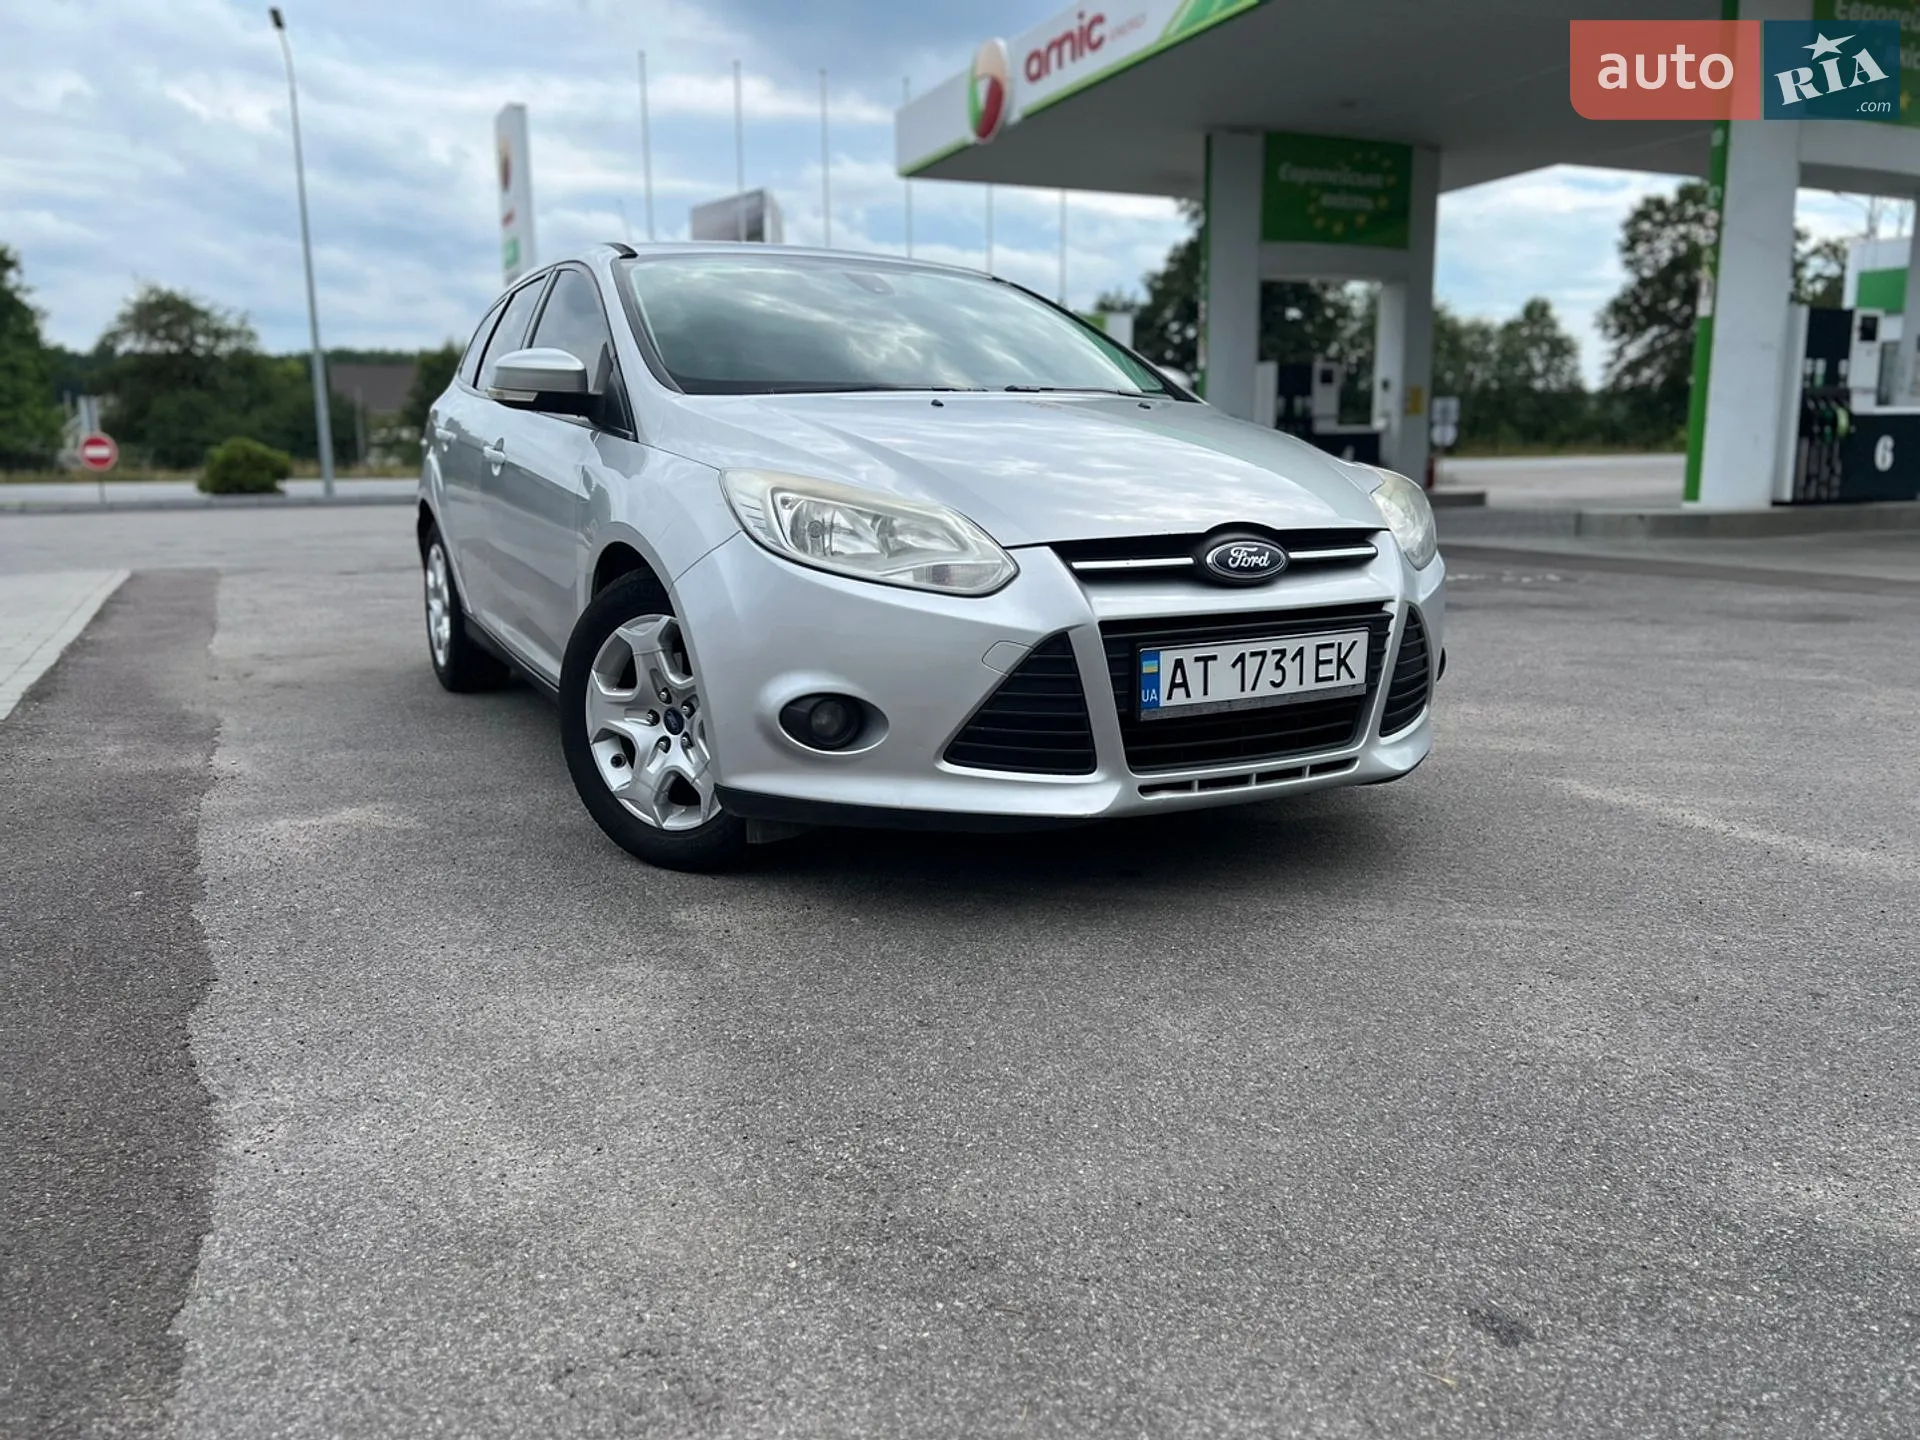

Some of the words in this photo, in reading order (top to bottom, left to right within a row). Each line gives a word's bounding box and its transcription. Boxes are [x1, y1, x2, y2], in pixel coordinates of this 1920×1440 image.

[1024, 11, 1105, 84] amic
[1874, 434, 1895, 472] 6
[1228, 546, 1271, 568] Ford
[1166, 654, 1218, 701] AT
[1230, 646, 1305, 693] 1731
[1314, 640, 1358, 684] EK
[1142, 688, 1158, 703] UA
